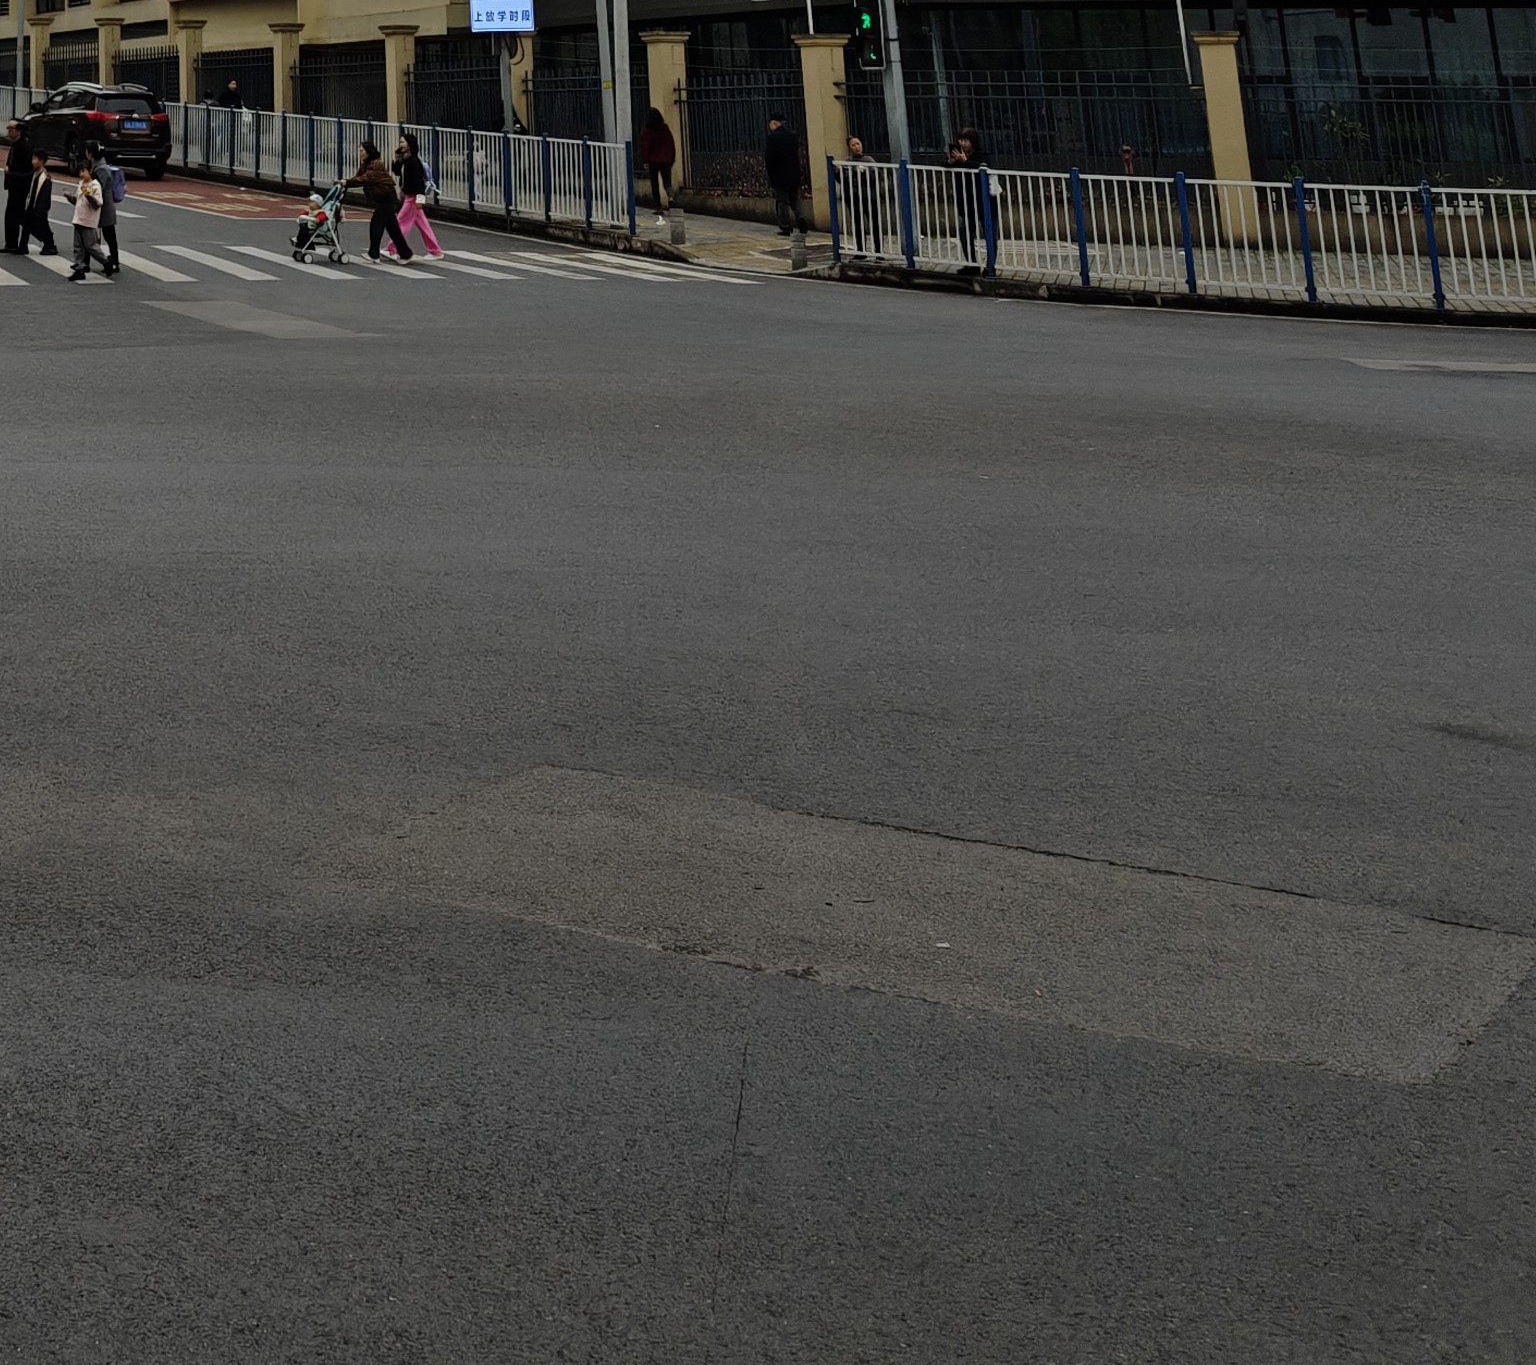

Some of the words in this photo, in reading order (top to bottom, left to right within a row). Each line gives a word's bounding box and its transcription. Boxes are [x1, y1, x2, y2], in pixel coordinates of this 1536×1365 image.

[474, 10, 530, 22] 上放学时段
